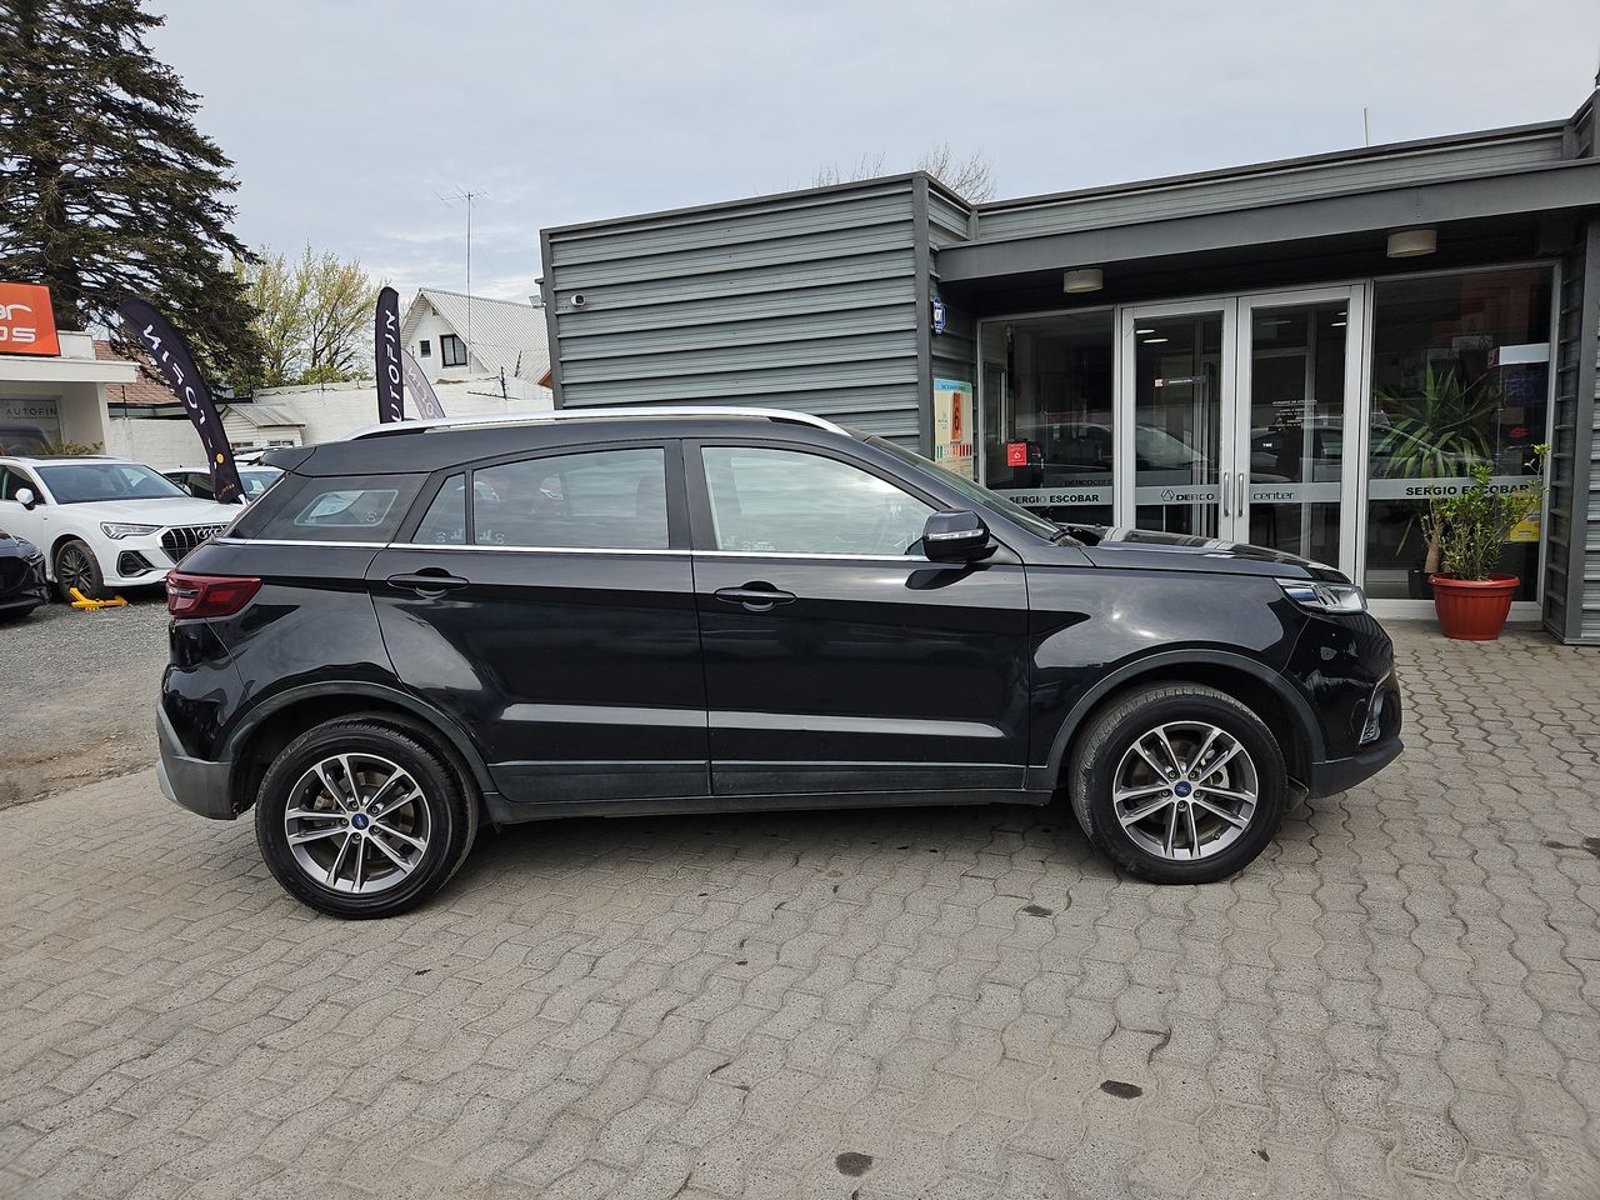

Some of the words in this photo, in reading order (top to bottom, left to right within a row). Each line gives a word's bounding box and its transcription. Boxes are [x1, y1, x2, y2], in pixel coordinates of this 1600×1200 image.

[1253, 491, 1295, 500] center
[1405, 486, 1457, 496] SERGIO
[1009, 495, 1047, 504] SERGIO
[1049, 494, 1100, 504] ESCOBAR
